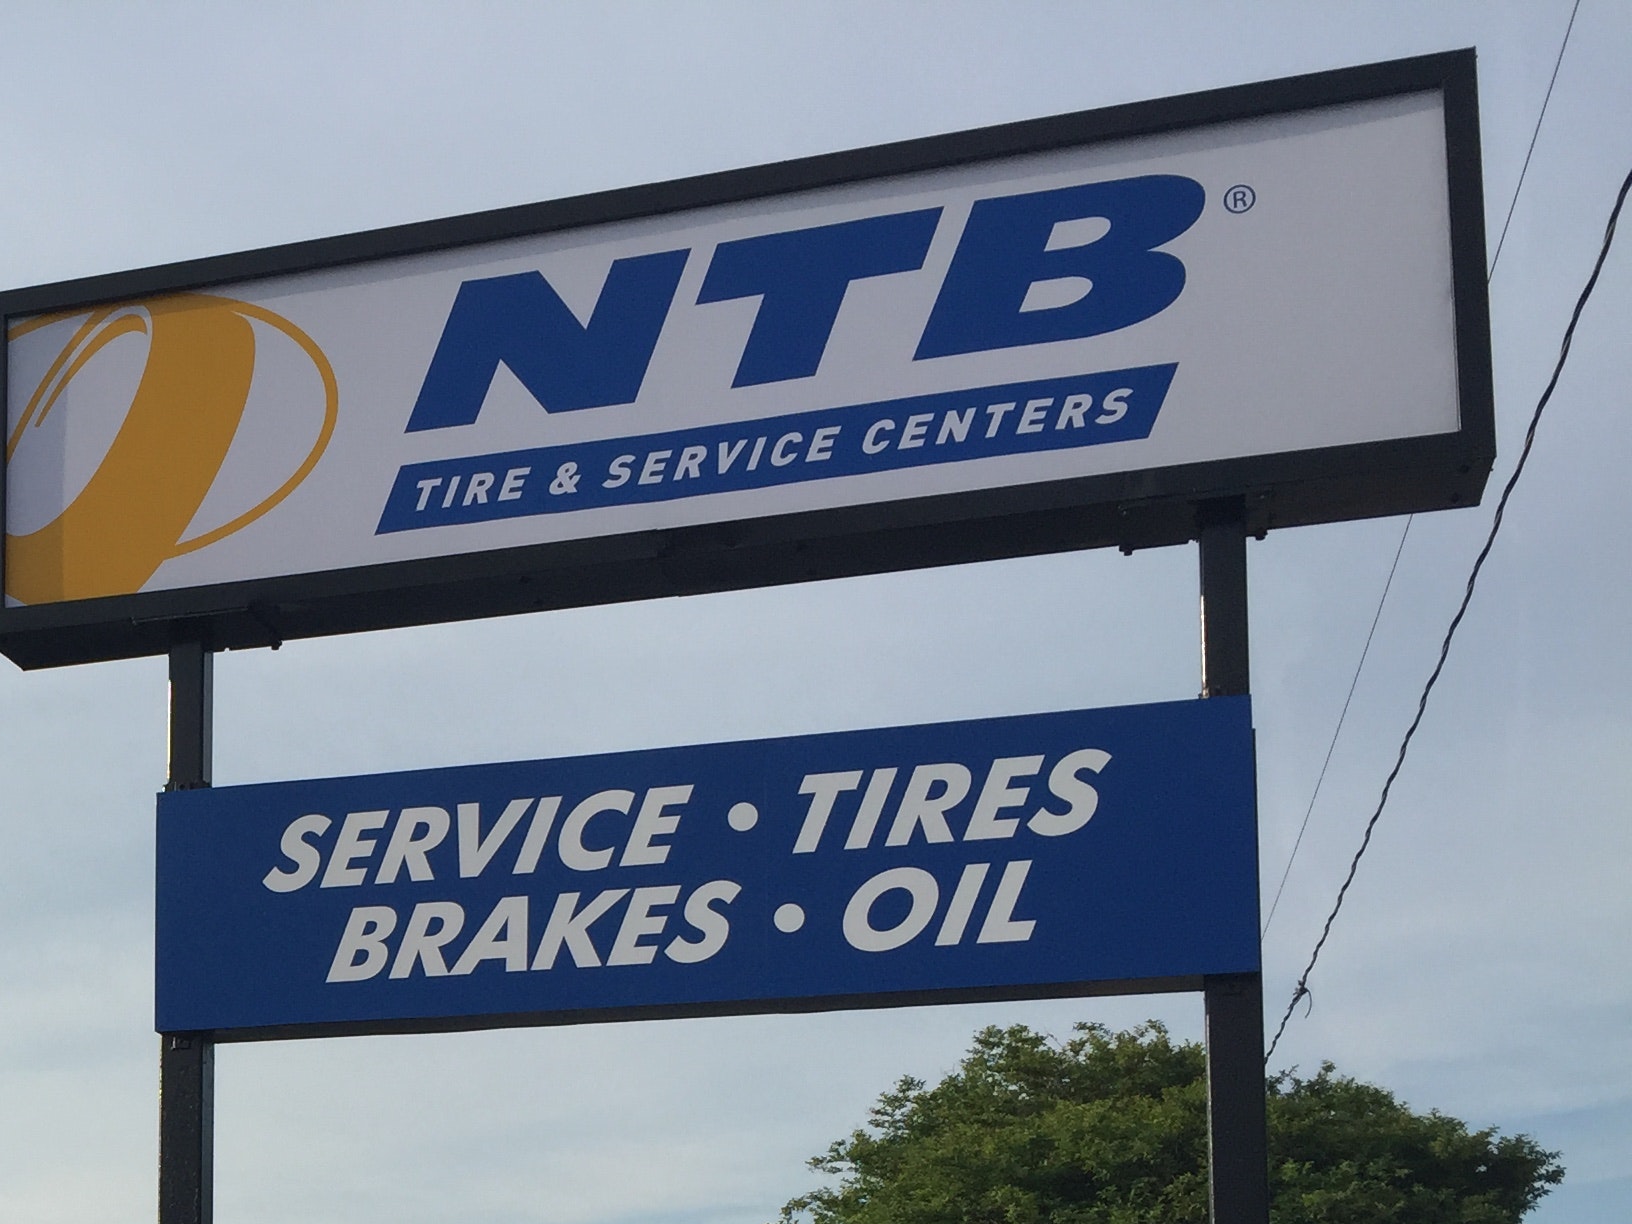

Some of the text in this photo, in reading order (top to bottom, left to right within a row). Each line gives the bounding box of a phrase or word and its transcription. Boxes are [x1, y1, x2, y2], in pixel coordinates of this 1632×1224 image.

[404, 173, 1206, 434] NTB
[414, 387, 1134, 514] TIRE & SERVICE CENTERS
[262, 747, 1113, 893] SERVICE TIRES
[324, 858, 1038, 984] BRAKES OIL
